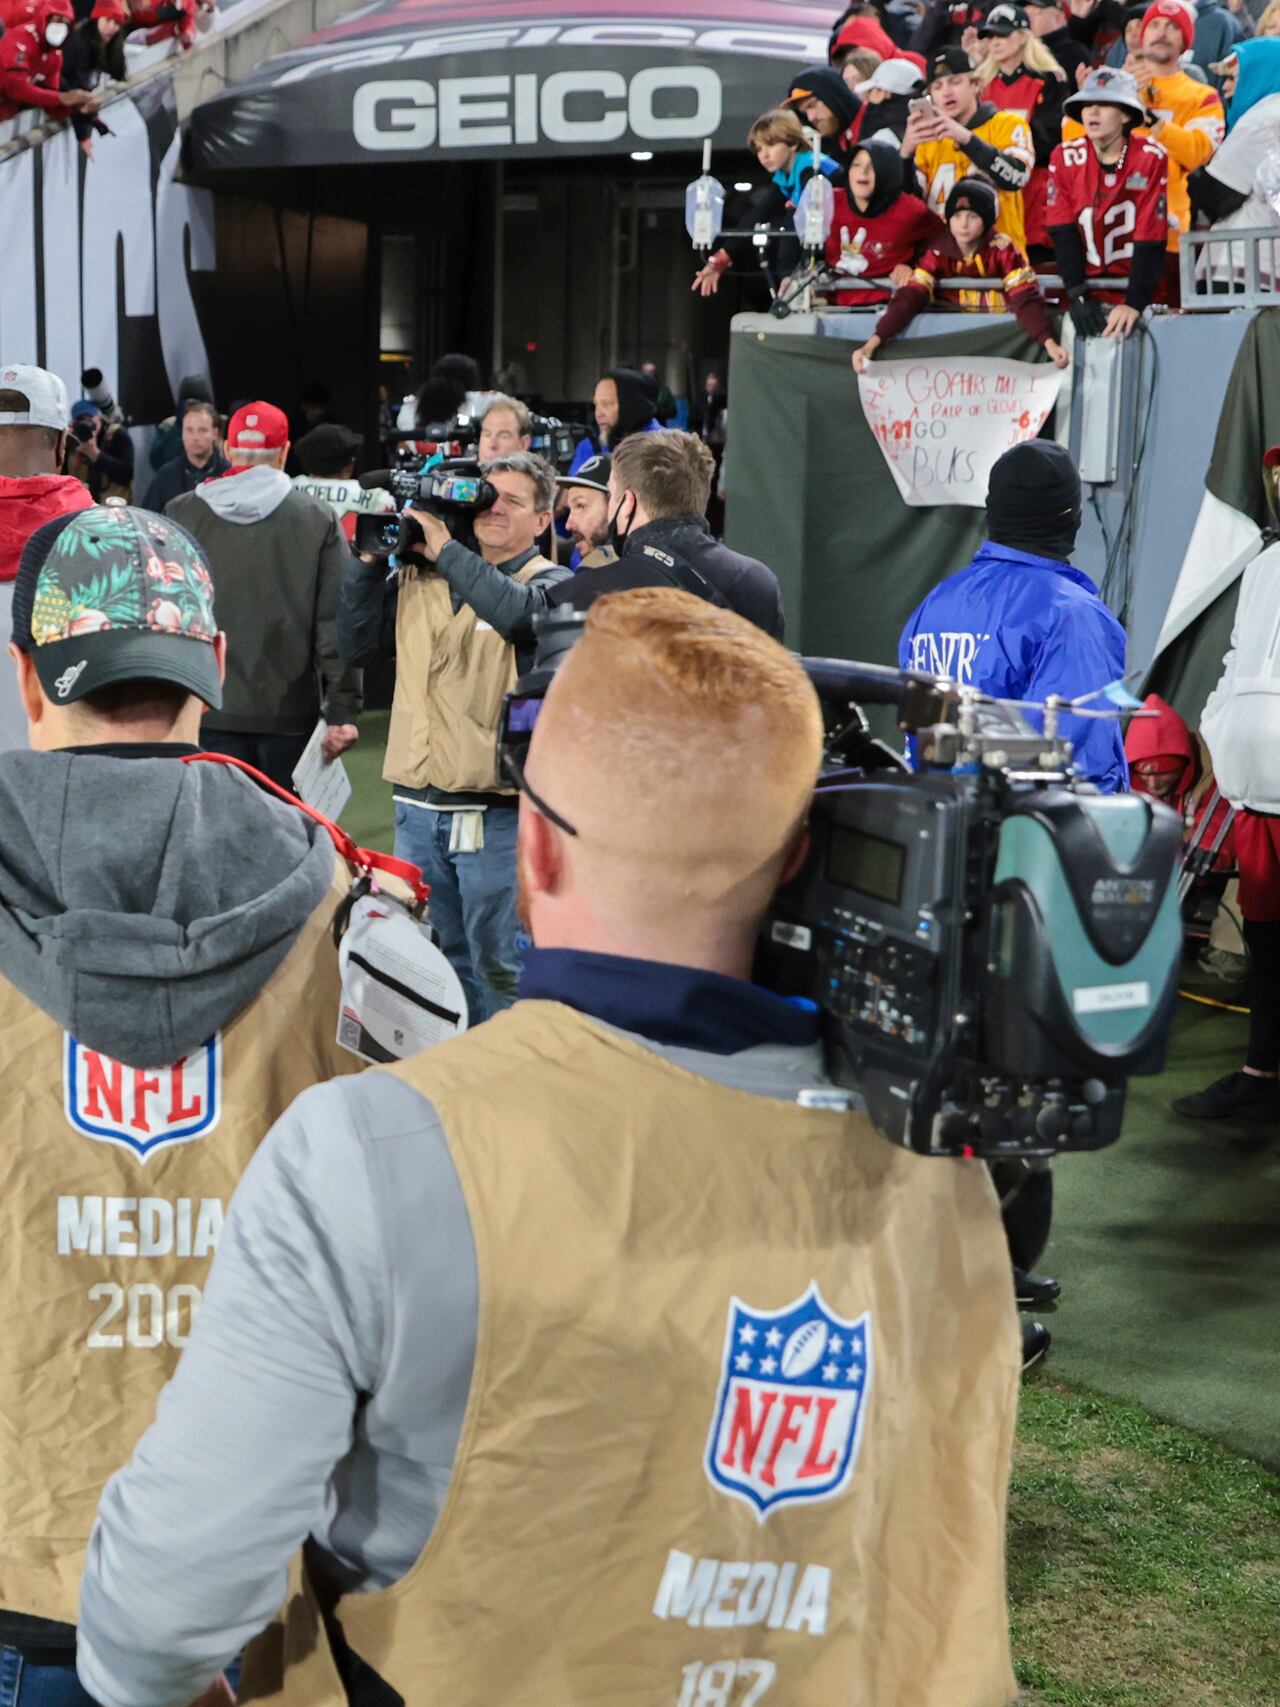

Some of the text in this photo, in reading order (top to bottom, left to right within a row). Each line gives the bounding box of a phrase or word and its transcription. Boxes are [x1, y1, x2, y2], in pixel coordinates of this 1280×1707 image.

[352, 65, 722, 150] GEICO
[1078, 199, 1136, 267] 12
[914, 420, 947, 440] GO
[909, 632, 990, 686] ENTR
[82, 1048, 202, 1134] NFL
[57, 1195, 226, 1258] MEDIA
[86, 1281, 203, 1349] 200
[721, 1385, 838, 1488] NFL
[652, 1547, 832, 1636] MEDIA
[676, 1657, 777, 1707] 187
